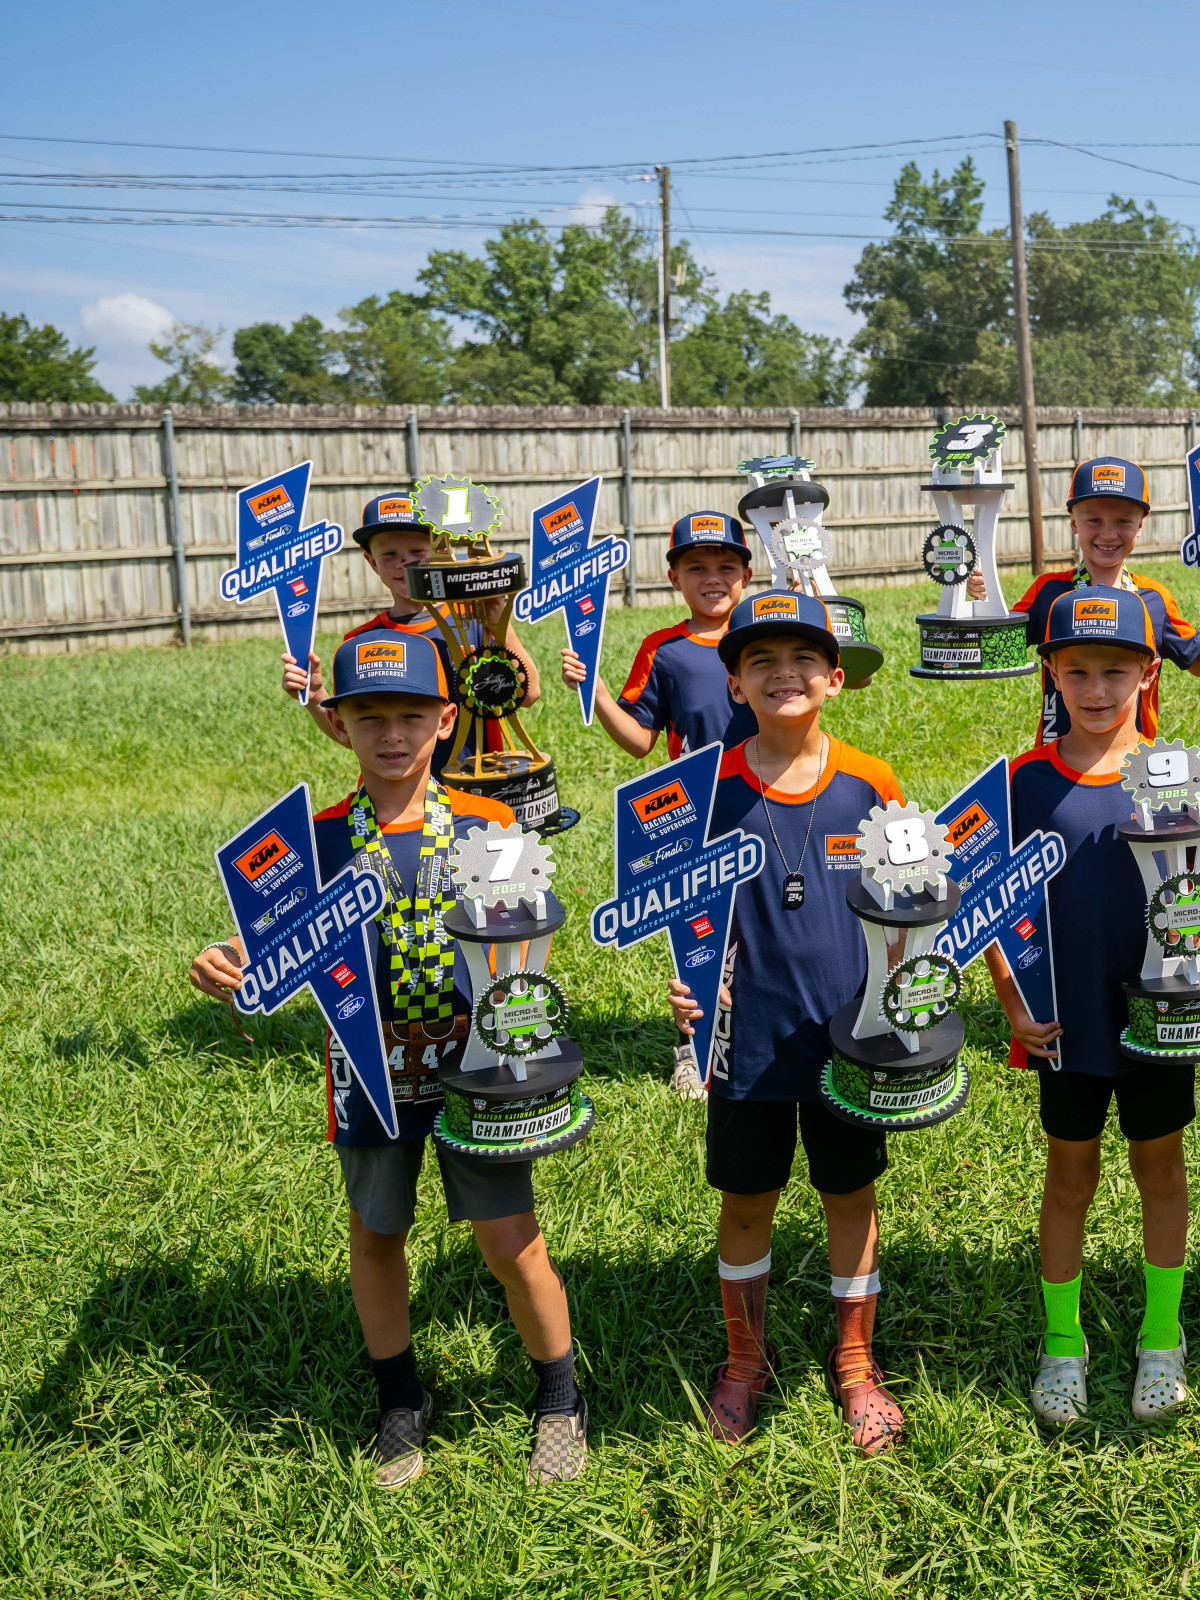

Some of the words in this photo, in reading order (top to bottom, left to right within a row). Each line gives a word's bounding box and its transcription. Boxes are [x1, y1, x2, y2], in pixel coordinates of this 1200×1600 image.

[946, 424, 994, 450] 3
[256, 508, 277, 521] RACING
[276, 501, 292, 512] TEAM
[258, 493, 281, 510] KTM
[441, 486, 472, 526] 1
[548, 525, 567, 539] RACING
[567, 518, 581, 529] TEAM
[550, 510, 572, 528] KTM
[227, 528, 338, 596] QUALIFIED
[447, 570, 500, 583] MICRO-E
[465, 578, 510, 592] LIMITED
[520, 544, 624, 616] QUALIFIED
[755, 613, 778, 622] RACING
[780, 612, 797, 620] TEAM
[760, 600, 790, 610] KTM
[1081, 604, 1110, 614] KTM
[1083, 628, 1115, 636] SUPERCROSS
[1100, 620, 1116, 628] TEAM
[364, 647, 397, 658] KTM
[924, 650, 978, 661] CHAMPIONSHIP
[358, 662, 382, 671] RACING
[386, 662, 404, 670] TEAM
[1148, 750, 1189, 787] 9
[645, 791, 678, 815] KTM
[1157, 788, 1188, 800] 2025
[431, 802, 446, 834] 2025
[643, 812, 672, 832] RACING
[671, 803, 693, 818] TEAM
[648, 831, 659, 840] JR.
[659, 813, 698, 836] SUPERCROSS
[952, 812, 980, 841] KTM
[885, 818, 928, 865] 8
[954, 833, 978, 857] RACING
[976, 819, 994, 837] TEAM
[961, 853, 971, 863] JR.
[969, 827, 1000, 857] SUPERCROSS
[248, 842, 279, 873] KTM
[486, 838, 524, 882] 7
[656, 839, 684, 864] Finals
[252, 865, 279, 889] RACING
[276, 851, 297, 870] TEAM
[261, 886, 272, 897] JR.
[269, 860, 304, 891] SUPERCROSS
[626, 884, 641, 895] LAS
[643, 873, 666, 888] VEGAS
[672, 860, 692, 874] MOTOR
[695, 841, 731, 864] SPEEDWAY
[898, 866, 928, 878] 2025
[492, 882, 526, 895] 2025
[601, 843, 757, 939] QUALIFIED
[273, 890, 300, 920] Finals
[633, 909, 680, 936] SEPTEMBER
[701, 889, 721, 903] 2025
[257, 944, 271, 958] LAS
[271, 927, 292, 947] VEGAS
[295, 909, 314, 927] MOTOR
[314, 881, 347, 911] SPEEDWAY
[694, 920, 708, 930] WELLS
[239, 878, 378, 1007] QUALIFIED
[275, 961, 317, 997] SEPTEMBER
[333, 932, 352, 951] 2025
[691, 951, 710, 966] Ford
[334, 967, 348, 979] WELLS
[908, 986, 938, 997] MICRO-E
[343, 999, 360, 1017] Ford
[504, 1007, 538, 1018] MICRO-E
[518, 1014, 542, 1022] LIMITED
[873, 1075, 954, 1106] CHAMPIONSHIP
[475, 1108, 569, 1137] CHAMPIONSHIP
